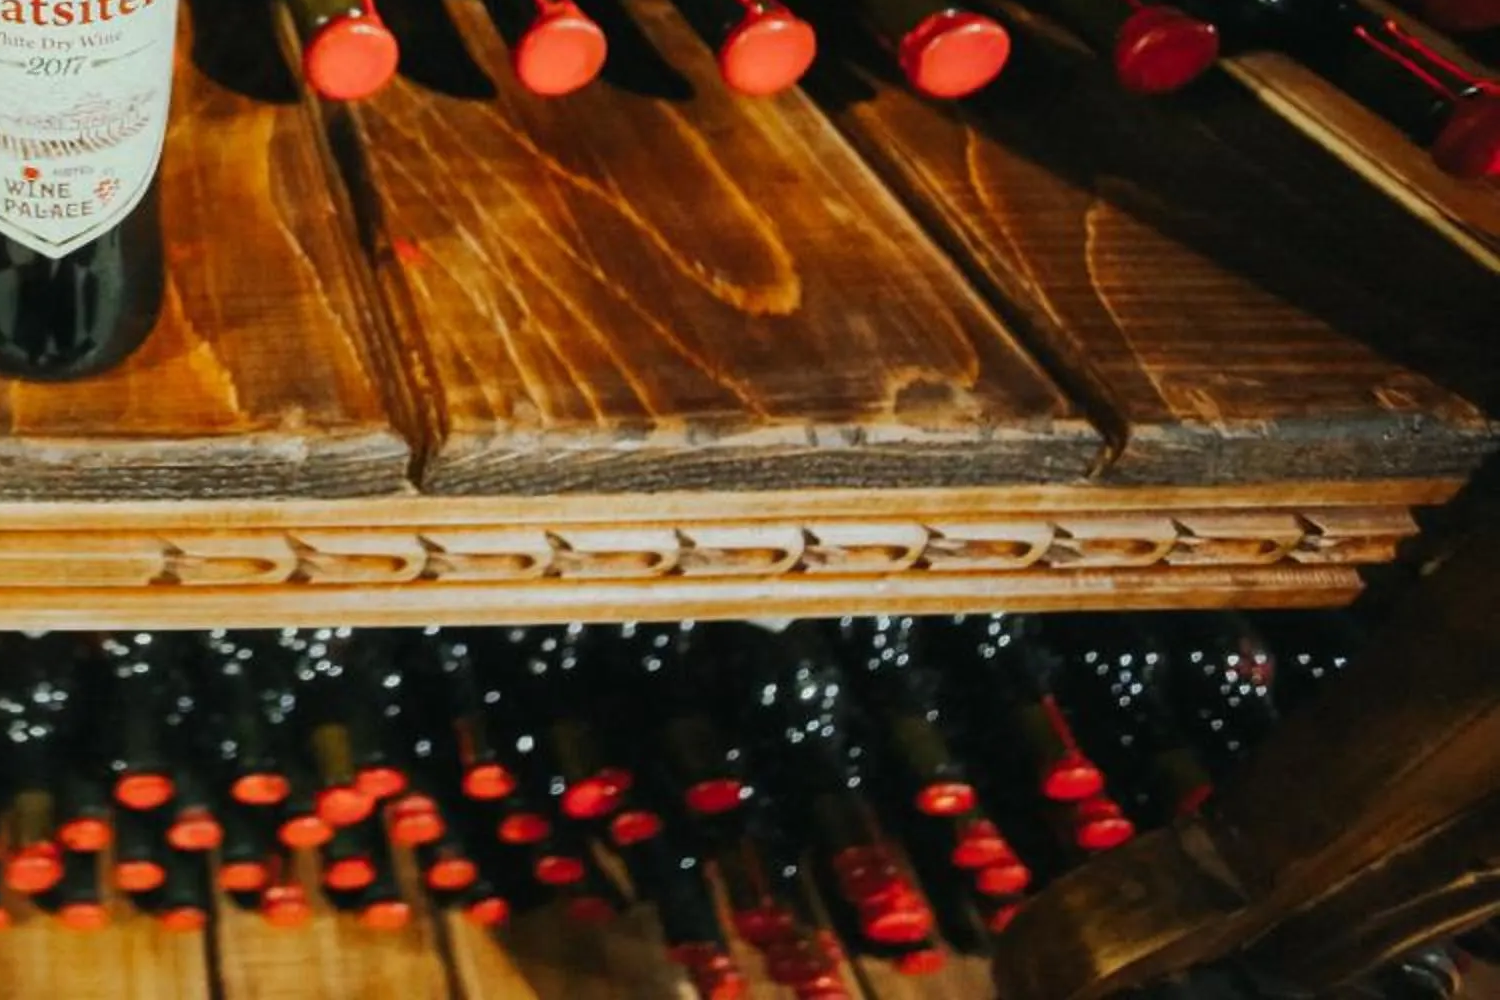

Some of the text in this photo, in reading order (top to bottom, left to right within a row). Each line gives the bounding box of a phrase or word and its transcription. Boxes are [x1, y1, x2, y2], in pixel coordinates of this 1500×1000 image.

[41, 37, 73, 53] Dry
[24, 55, 89, 77] 2017
[3, 177, 73, 199] WINE
